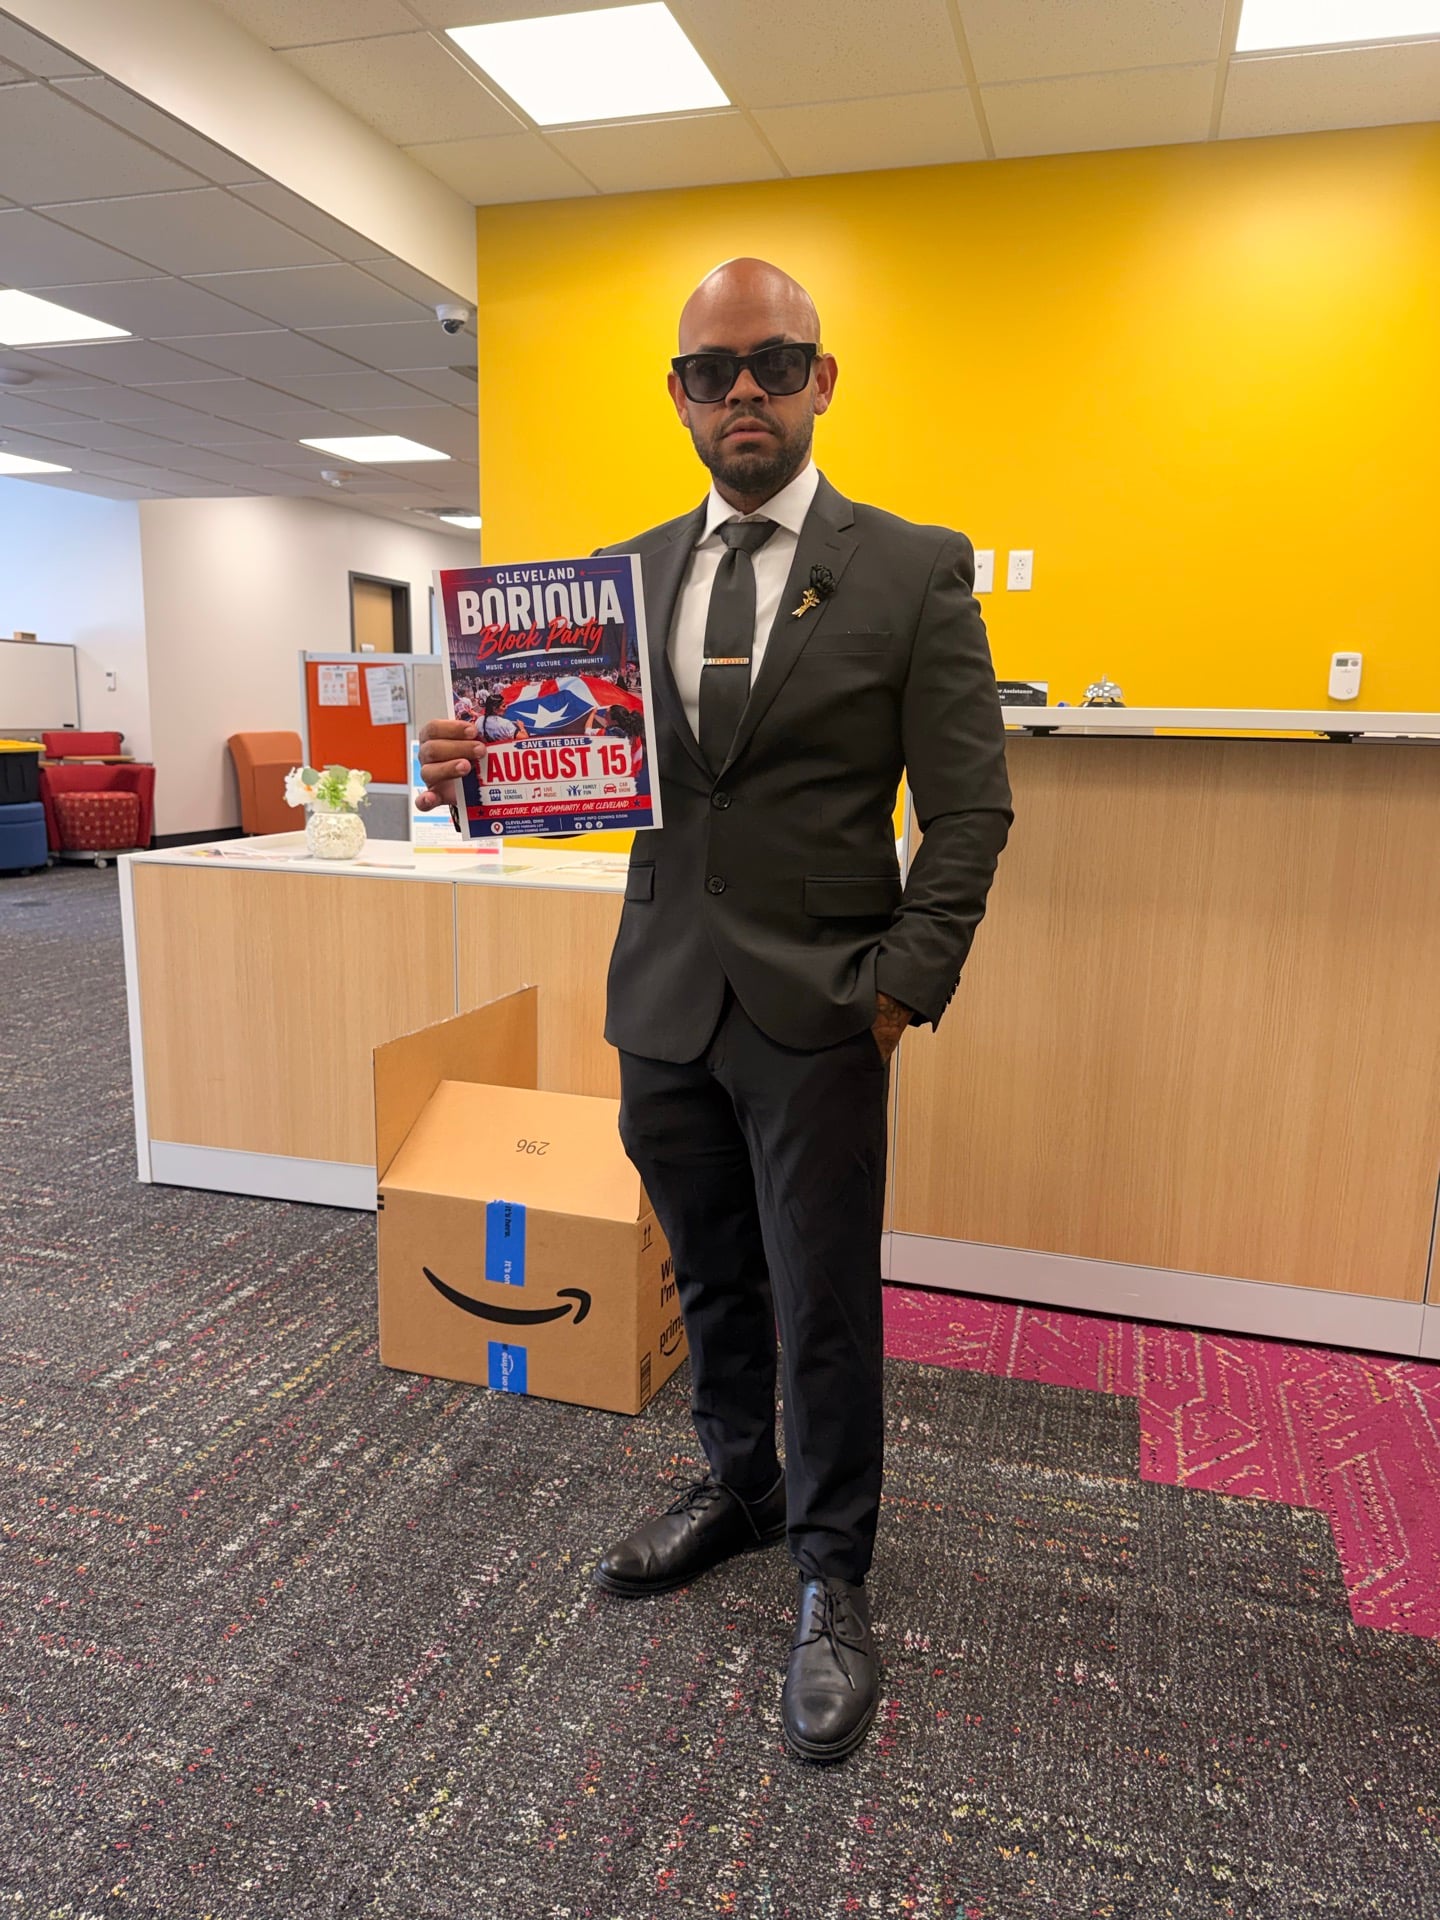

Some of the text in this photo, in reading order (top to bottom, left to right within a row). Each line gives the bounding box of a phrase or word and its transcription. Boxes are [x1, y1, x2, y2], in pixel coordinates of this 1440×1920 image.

[496, 567, 575, 585] CLEVELAND
[457, 579, 625, 635] BORIQUA
[476, 616, 605, 661] Block Party
[485, 663, 503, 671] MUSIC
[536, 660, 561, 668] CULTURE
[570, 657, 604, 665] COMMUNITY
[521, 737, 586, 749] SAVE THE DATE
[486, 744, 627, 783] AUGUST 15
[488, 808, 503, 816] ONE
[530, 805, 545, 814] ONE
[582, 802, 596, 811] ONE
[515, 1139, 551, 1156] 296
[504, 1273, 511, 1285] on
[661, 1281, 676, 1308] I'm
[500, 1351, 510, 1375] prime
